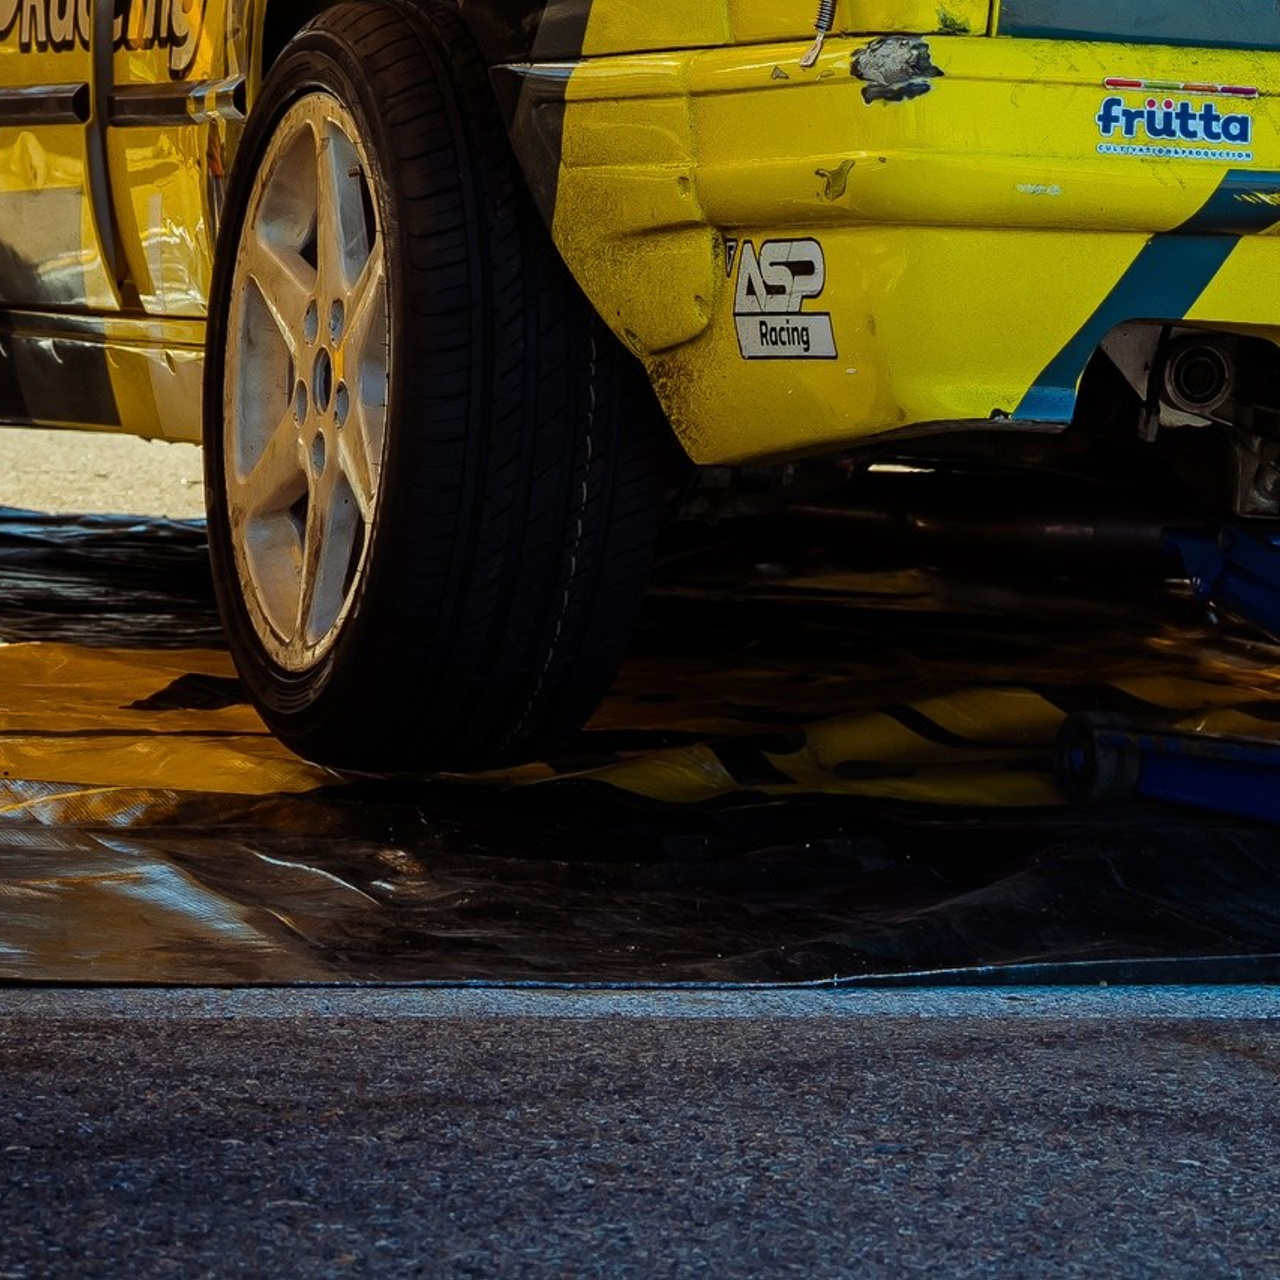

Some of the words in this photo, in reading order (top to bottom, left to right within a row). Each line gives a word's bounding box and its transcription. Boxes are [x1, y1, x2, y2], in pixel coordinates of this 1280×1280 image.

[1097, 97, 1251, 143] frütta
[734, 239, 825, 313] ASP
[759, 319, 810, 352] Racing
